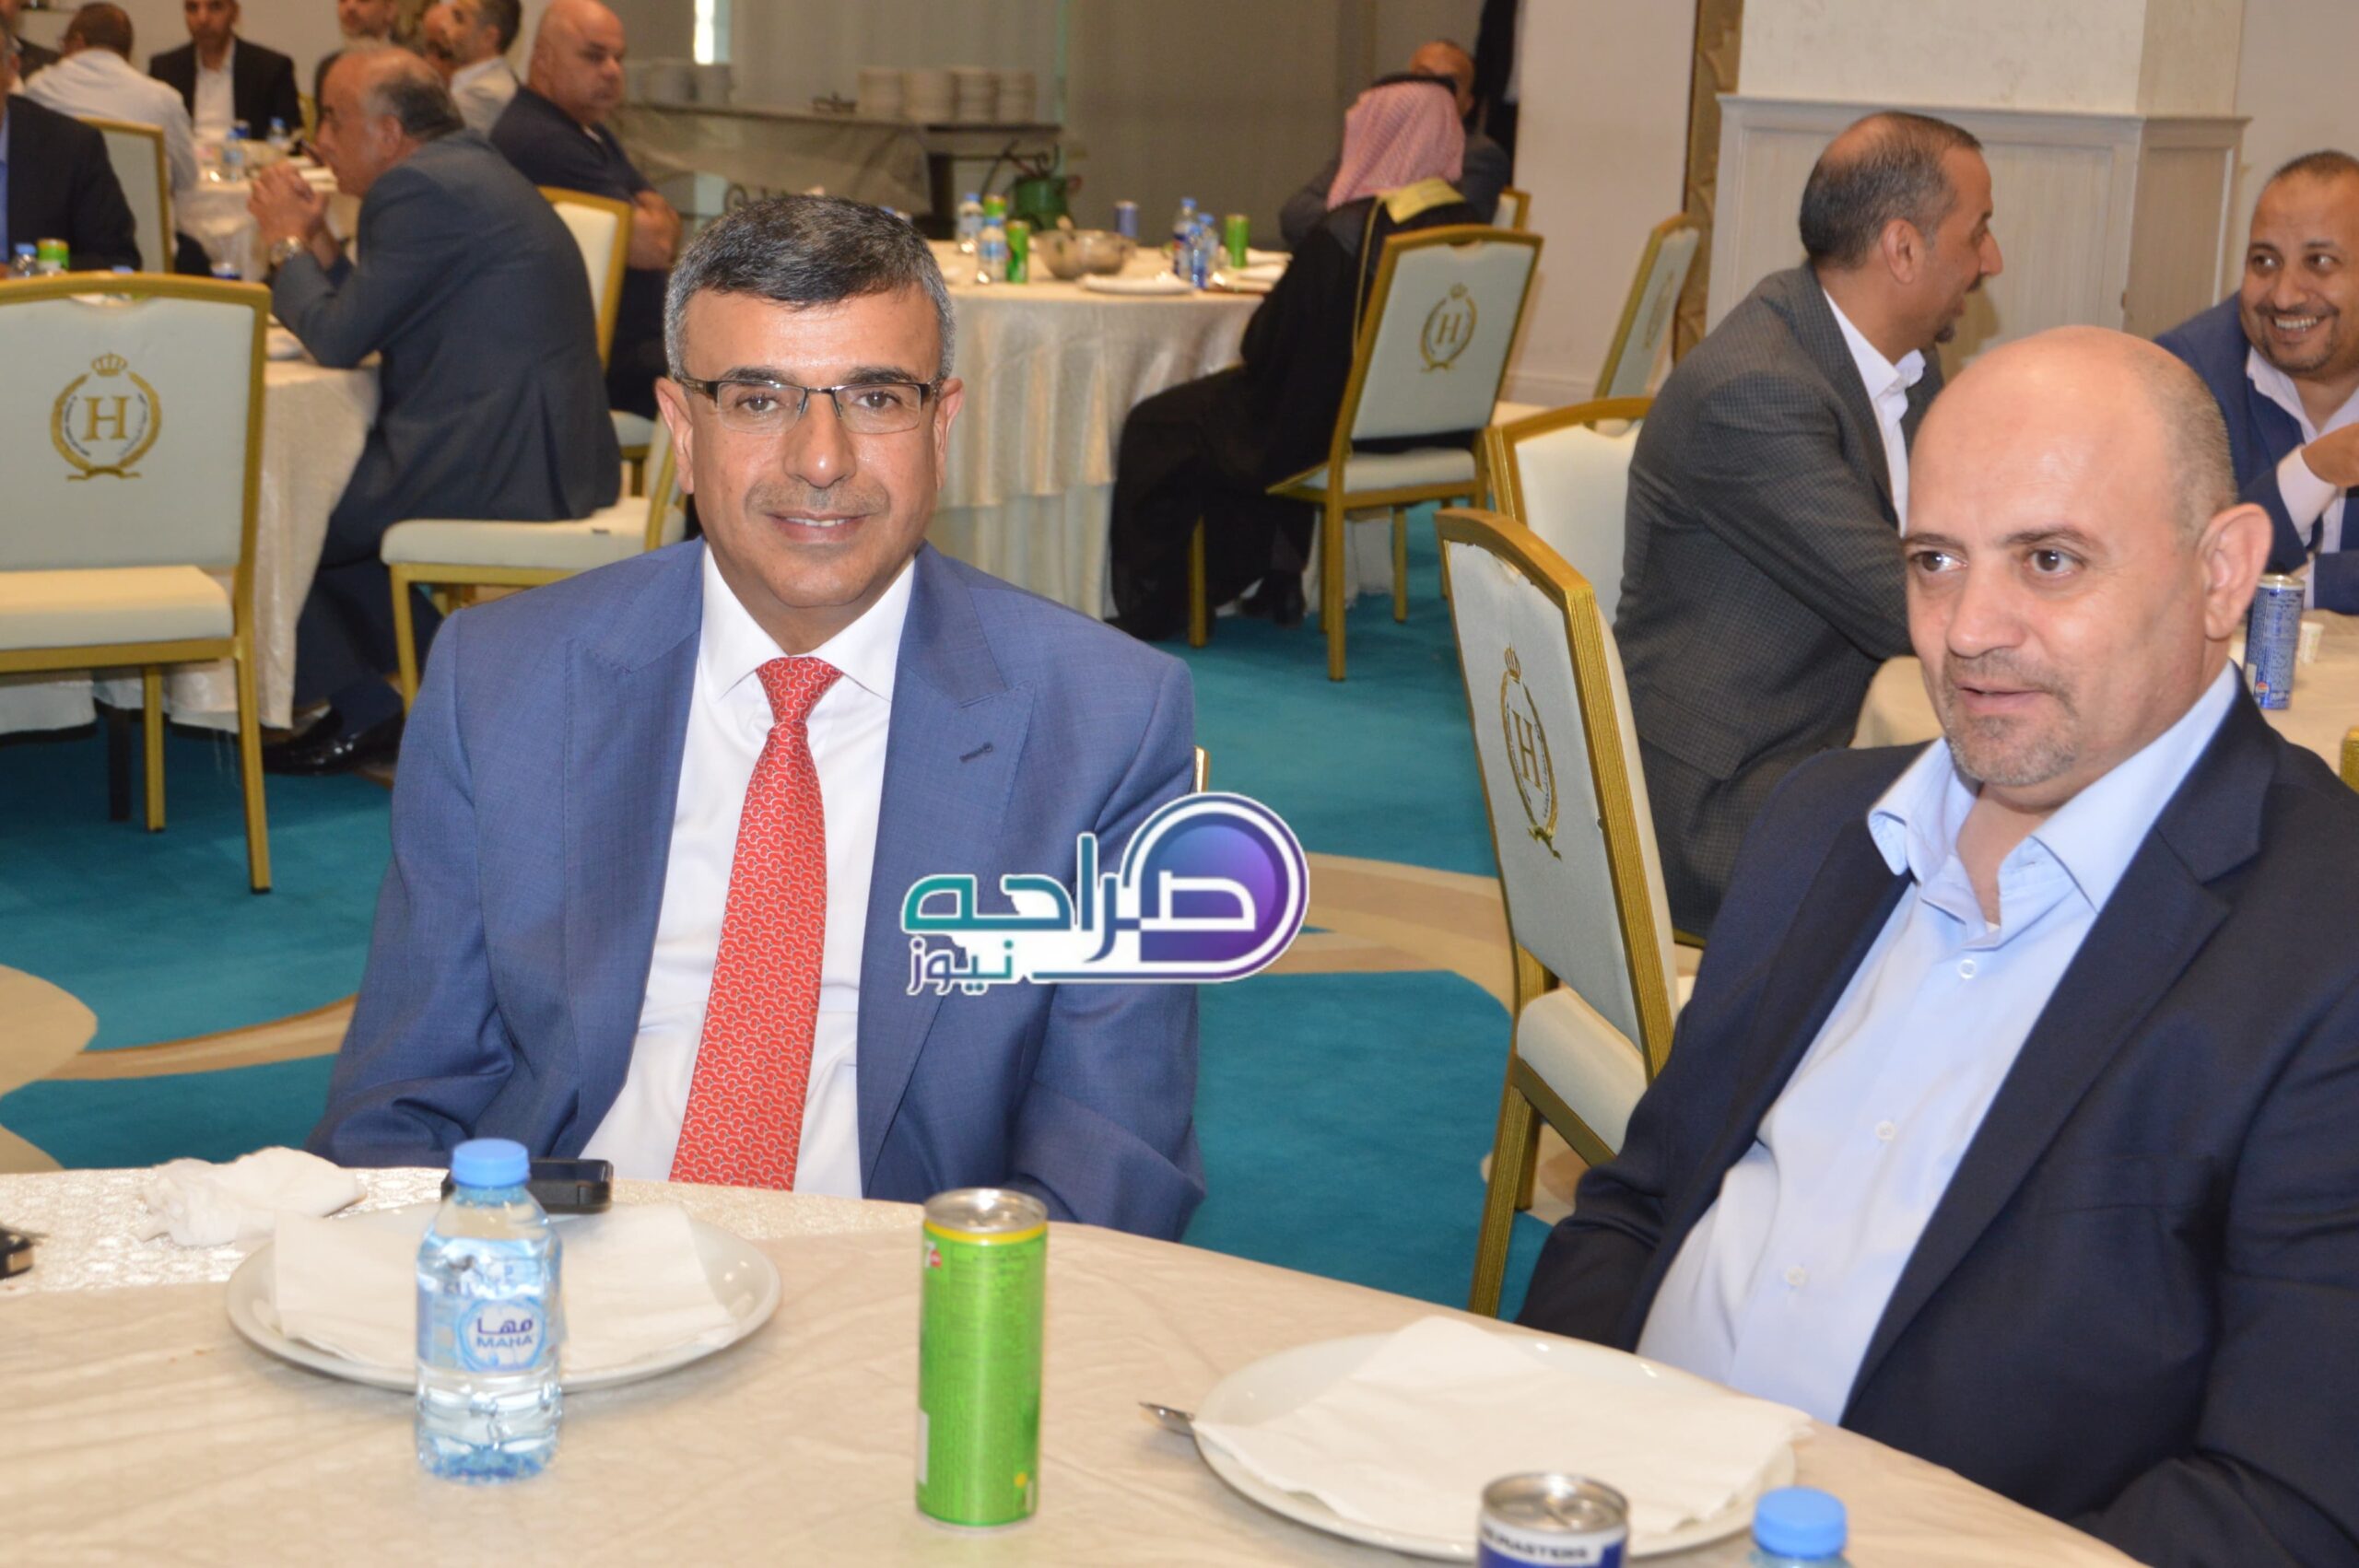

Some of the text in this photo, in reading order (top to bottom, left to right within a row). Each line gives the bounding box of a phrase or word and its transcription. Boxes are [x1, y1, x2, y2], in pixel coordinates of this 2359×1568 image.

[81, 395, 132, 441] H
[1512, 708, 1545, 793] H
[476, 1335, 534, 1348] MAHA
[477, 1317, 534, 1335] مها
